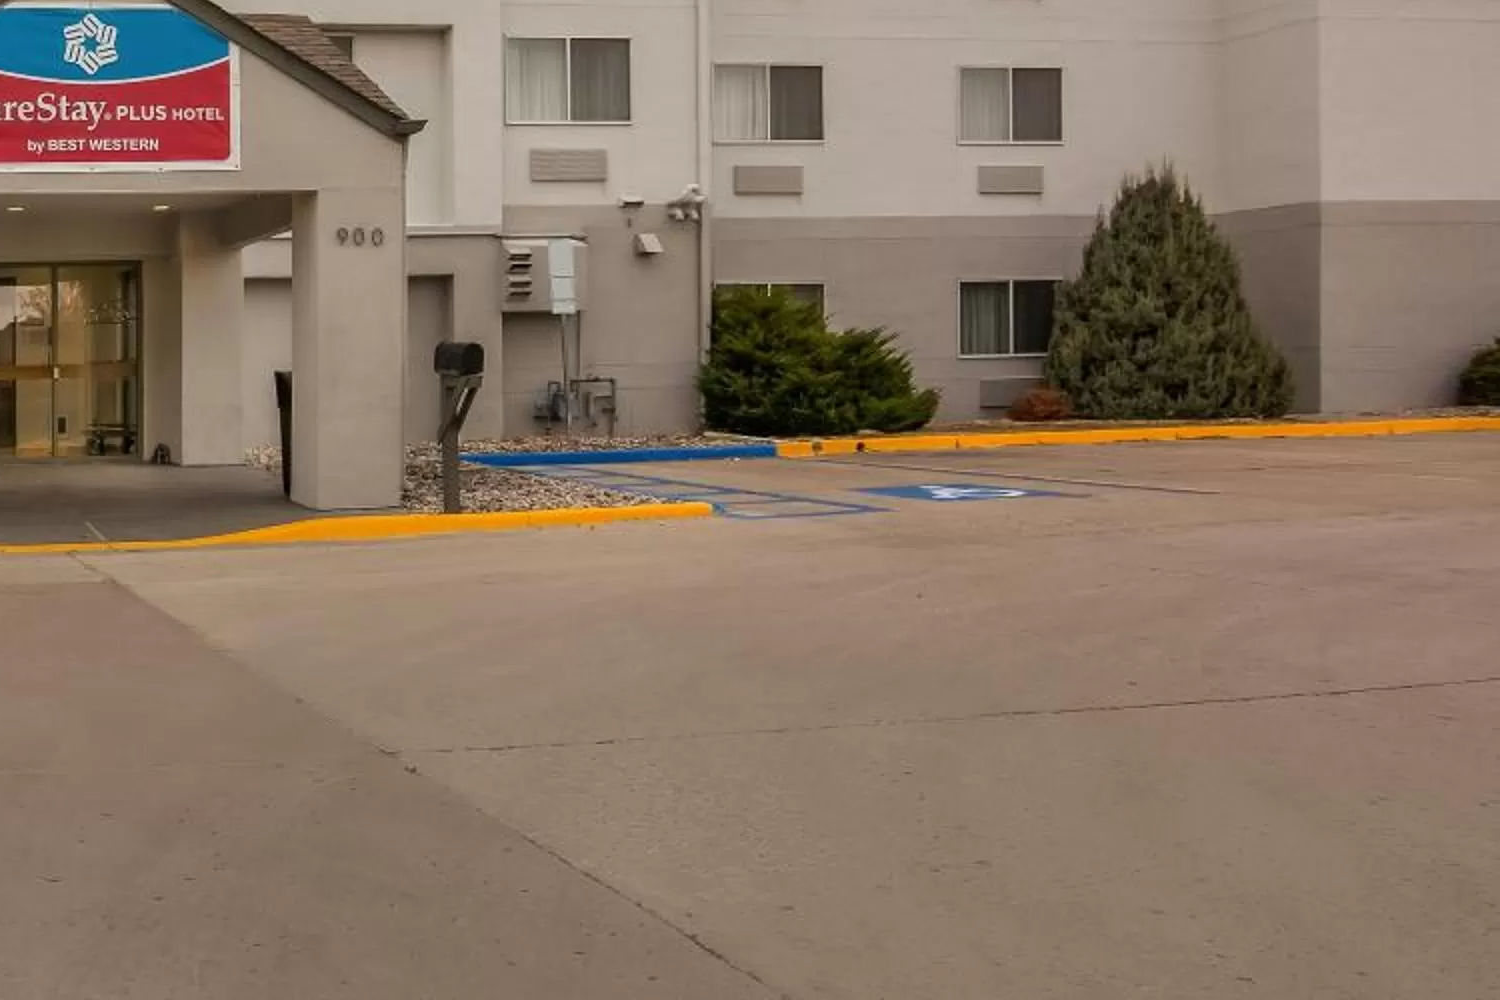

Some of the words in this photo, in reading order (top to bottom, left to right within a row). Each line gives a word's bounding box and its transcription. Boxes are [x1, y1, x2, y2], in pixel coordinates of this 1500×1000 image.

[115, 105, 168, 121] PLUS
[171, 107, 225, 121] HOTEL
[26, 138, 45, 155] by
[48, 139, 86, 151] BEST
[89, 139, 159, 151] WESTERN
[336, 227, 385, 248] 900
